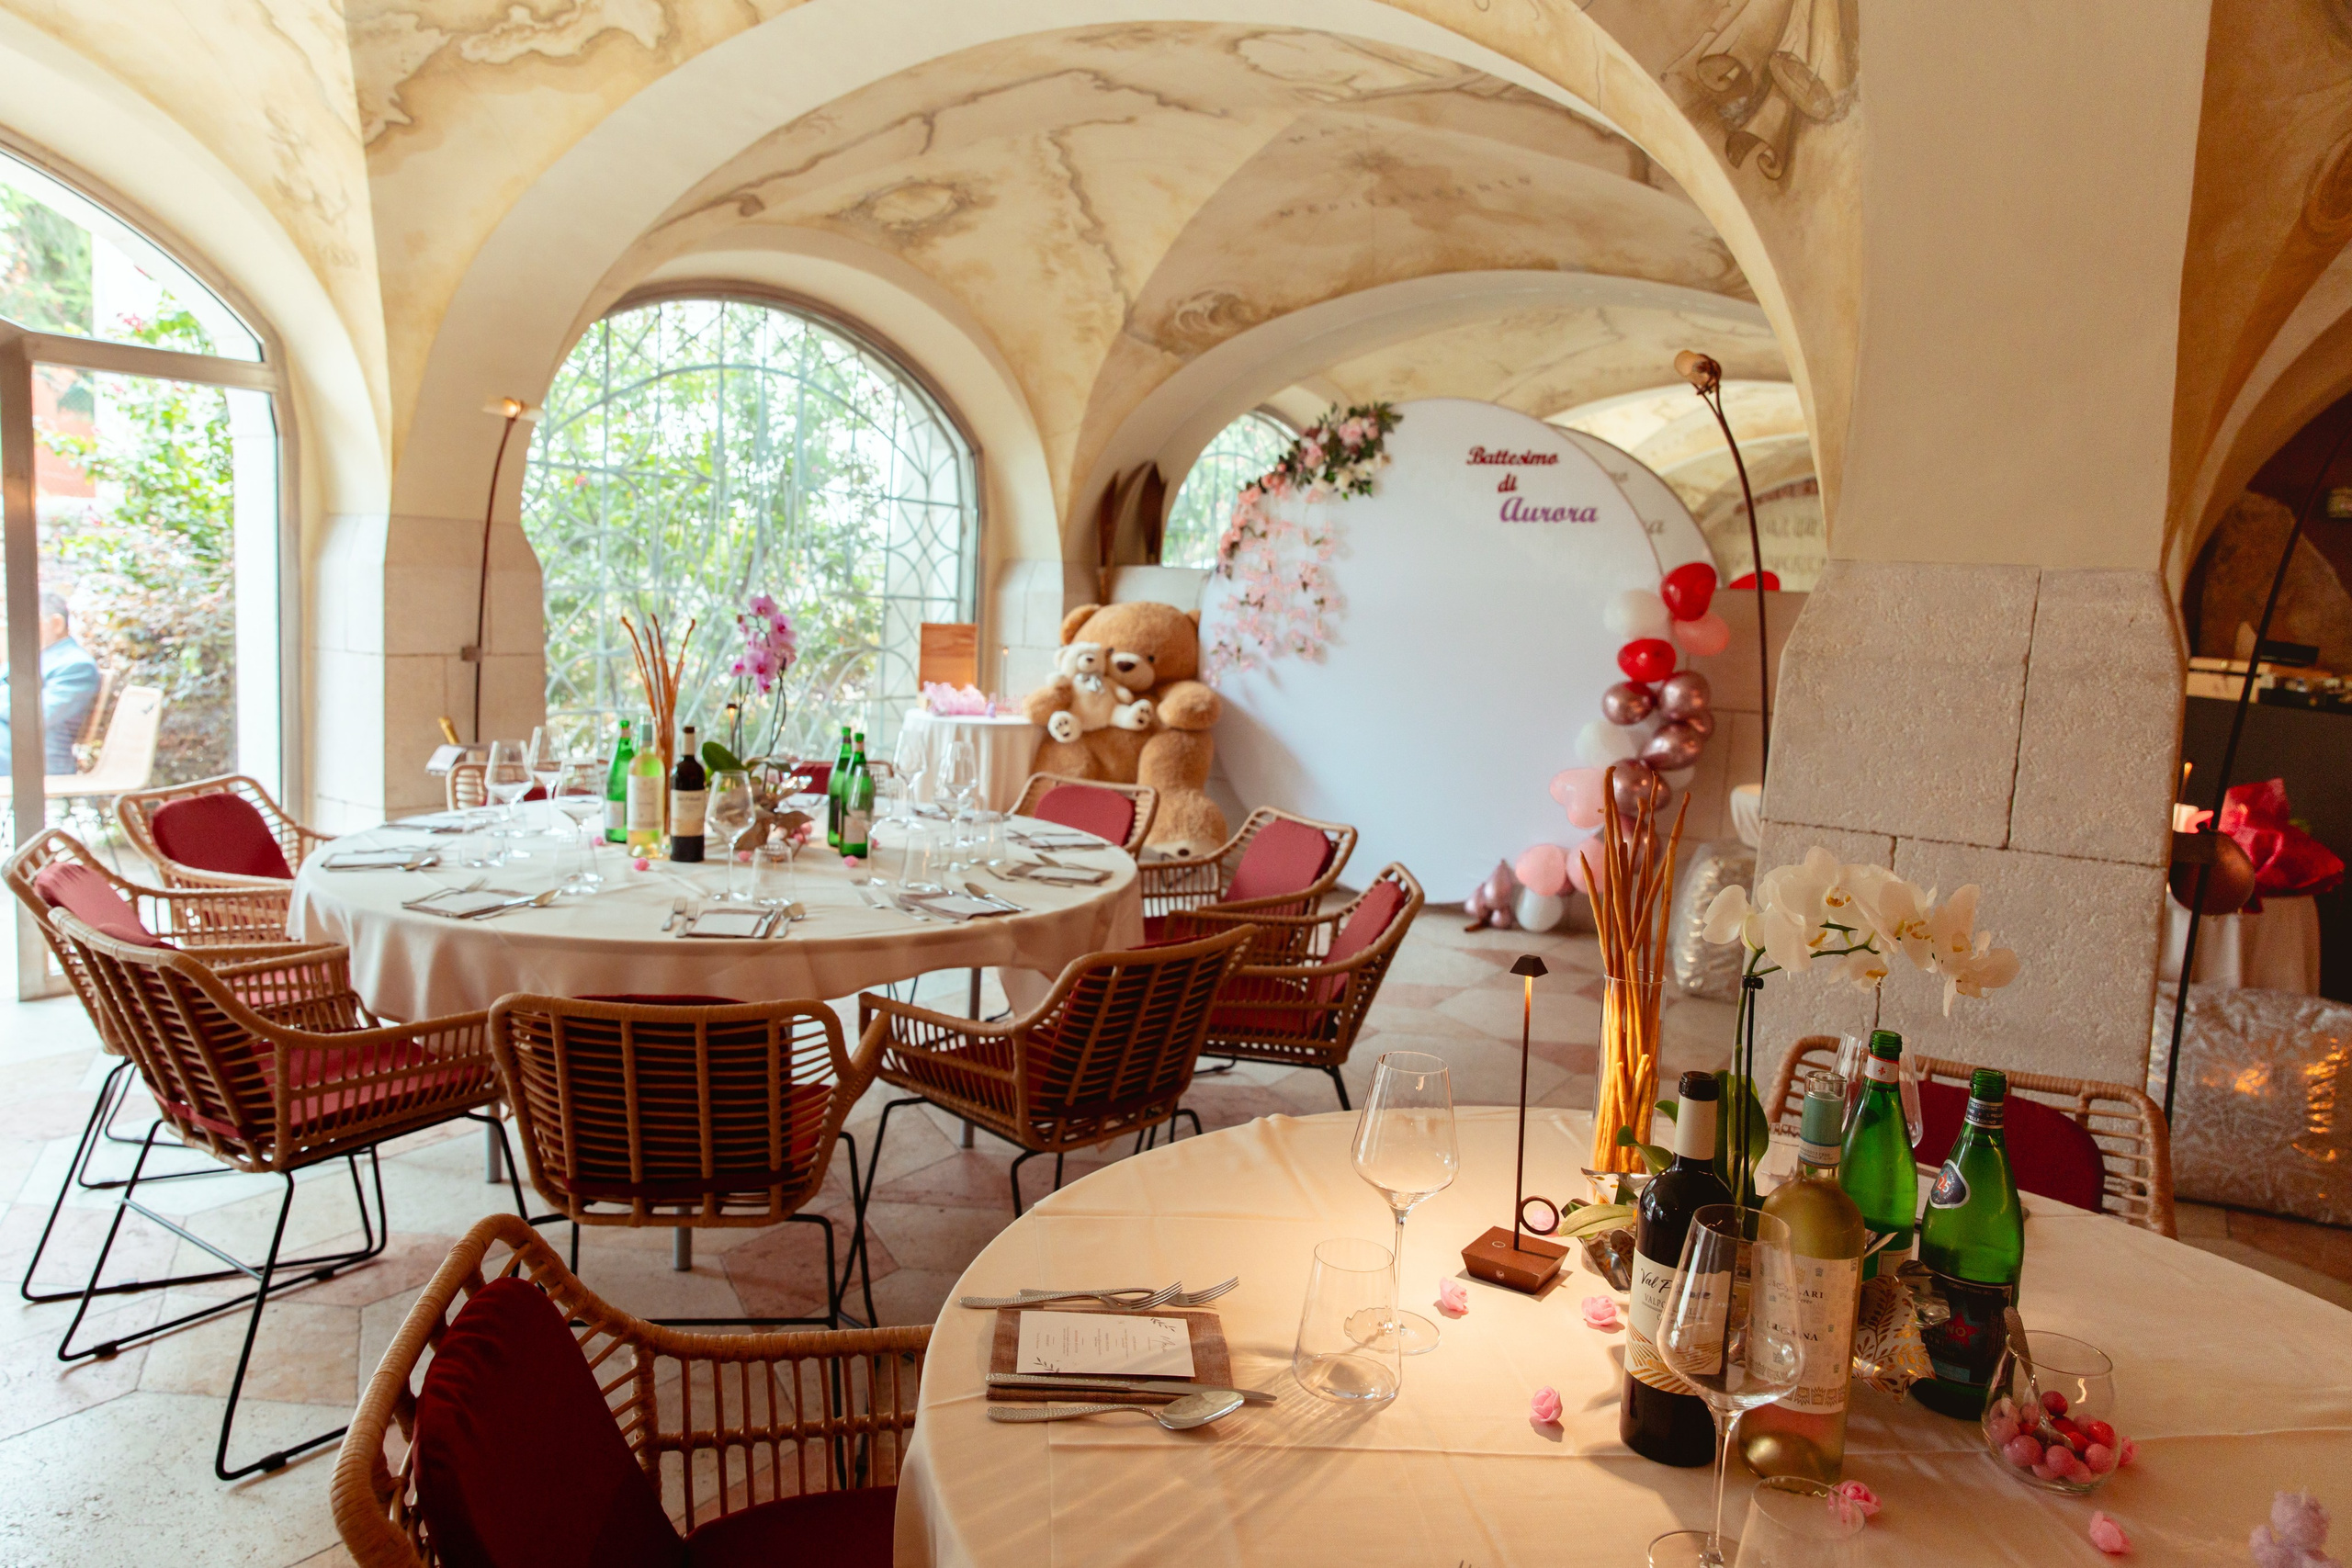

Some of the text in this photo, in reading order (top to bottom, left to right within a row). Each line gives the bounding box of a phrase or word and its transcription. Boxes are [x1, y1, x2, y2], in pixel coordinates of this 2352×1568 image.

[1466, 445, 1559, 466] Battesimo
[1497, 472, 1518, 493] di
[1499, 496, 1599, 524] Aurora
[1640, 1268, 1660, 1289] Val
